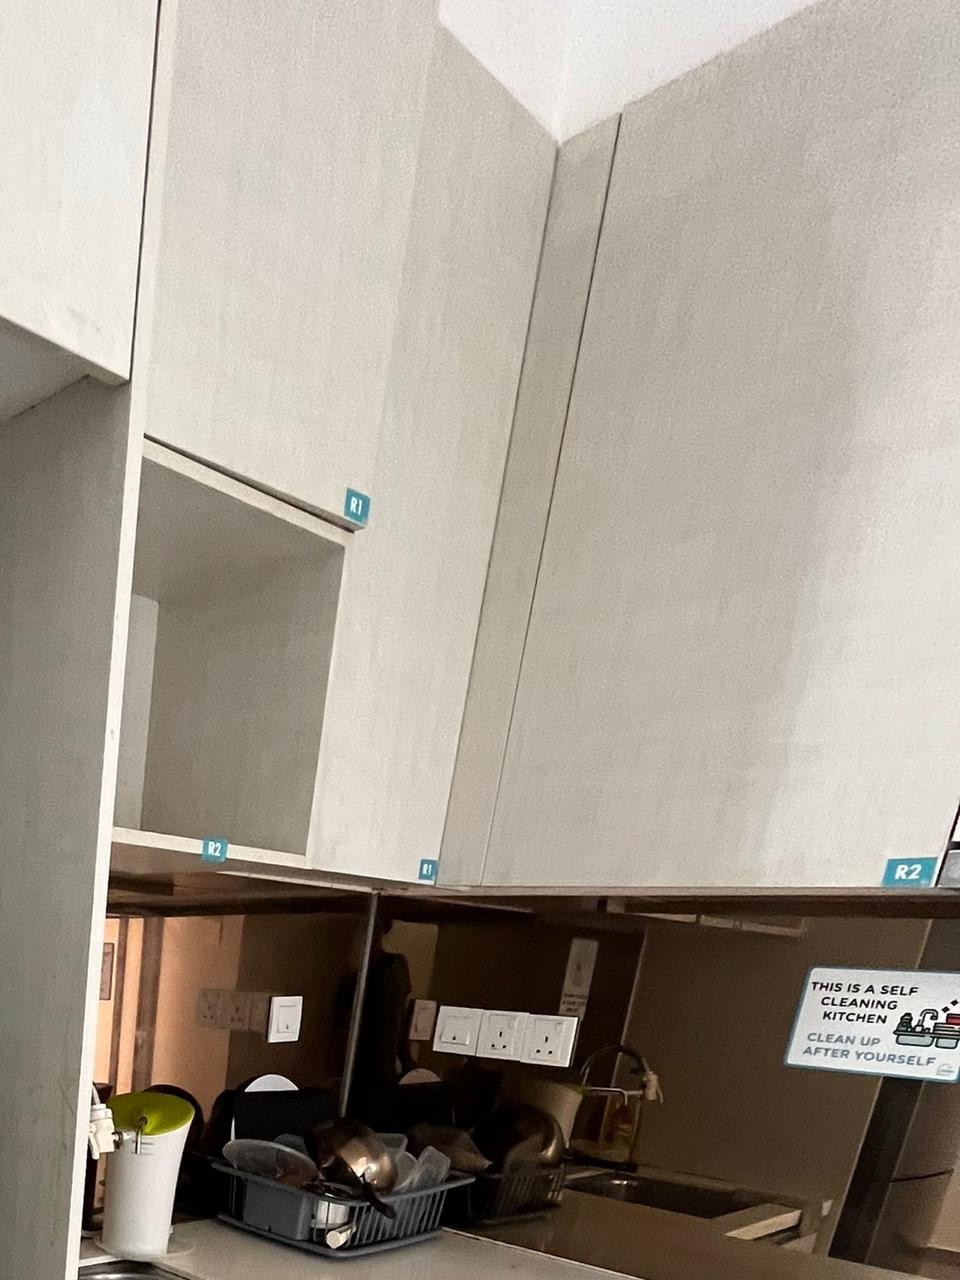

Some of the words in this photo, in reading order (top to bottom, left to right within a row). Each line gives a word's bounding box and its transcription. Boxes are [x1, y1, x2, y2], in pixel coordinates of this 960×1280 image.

[350, 496, 363, 516] R1
[208, 841, 222, 857] R2
[895, 863, 922, 880] R2
[811, 981, 843, 993] THIS
[847, 983, 861, 993] IS
[864, 984, 875, 994] A
[880, 985, 920, 996] SELF
[821, 996, 898, 1010] CLEANING
[822, 1011, 888, 1024] KITCHEN
[807, 1032, 856, 1045] CLEAN
[860, 1036, 881, 1047] UP
[802, 1046, 850, 1059] AFTER
[855, 1050, 937, 1067] YOURSELF
